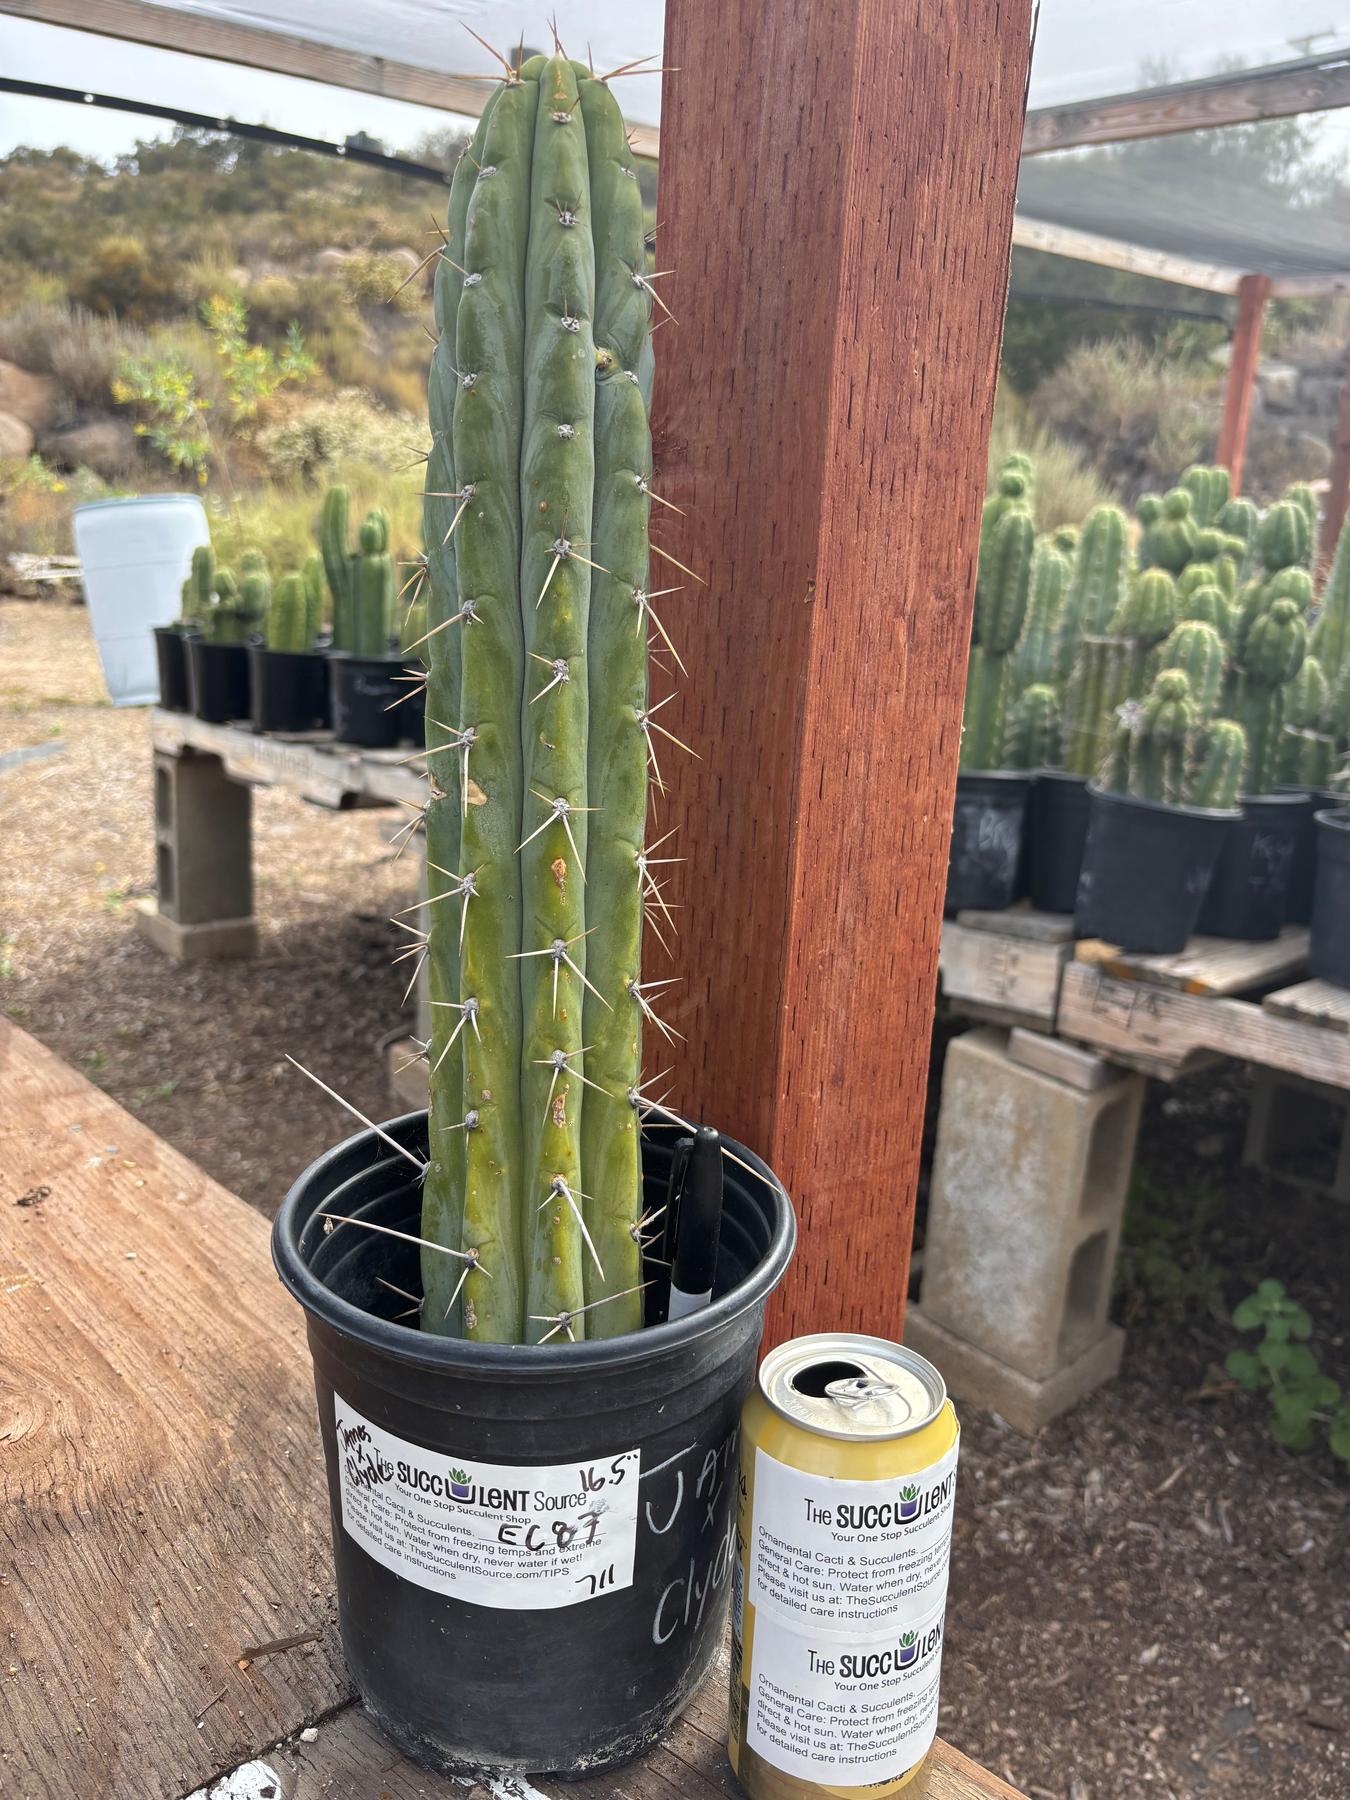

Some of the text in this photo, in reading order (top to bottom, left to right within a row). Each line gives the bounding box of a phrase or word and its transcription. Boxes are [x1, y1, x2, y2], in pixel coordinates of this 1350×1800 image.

[385, 1496, 406, 1514] Cacti
[408, 1510, 415, 1519] &
[417, 1513, 475, 1537] Succulents.
[395, 1483, 532, 1526] Your One Stop Succulent Shop
[534, 1491, 587, 1512] Source
[371, 1509, 382, 1523] hot
[404, 1529, 430, 1547] Water
[433, 1542, 459, 1557] when
[484, 1557, 514, 1568] never
[518, 1560, 548, 1568] water
[551, 1558, 559, 1566] if
[560, 1553, 583, 1565] wet!
[372, 1499, 392, 1518] Care:
[395, 1513, 426, 1535] Protect
[428, 1530, 450, 1543] from
[453, 1537, 495, 1555] freezing
[498, 1546, 532, 1558] temps
[535, 1546, 555, 1556] and
[559, 1538, 602, 1554] extreme
[759, 1525, 918, 1566] Ornamental Cacti & Succulents.
[832, 1532, 855, 1542] Your
[857, 1534, 878, 1542] One
[880, 1531, 902, 1541] Stop
[904, 1512, 939, 1536] Succulent
[356, 1520, 382, 1545] detailed
[384, 1543, 402, 1555] care
[404, 1552, 456, 1579] instructions
[369, 1519, 382, 1535] visit
[384, 1531, 394, 1541] us
[397, 1538, 407, 1548] at:
[409, 1543, 570, 1579] TheSucculentSource.com/TIPS
[758, 1539, 792, 1566] General
[795, 1560, 824, 1576] Care:
[828, 1568, 868, 1579] Protect
[871, 1567, 895, 1579] from
[898, 1552, 933, 1573] freezing
[757, 1564, 786, 1589] Please
[788, 1586, 809, 1599] visit
[812, 1594, 825, 1603] us
[828, 1595, 843, 1604] at:
[758, 1553, 780, 1573] direct
[782, 1568, 790, 1578] &
[792, 1572, 810, 1585] hot
[812, 1581, 836, 1591] sun.
[840, 1582, 873, 1592] Water
[876, 1579, 903, 1590] when
[757, 1577, 898, 1620] for detailed care instructions
[759, 1673, 916, 1713] Ornamental Cacti & Succulents.
[834, 1682, 857, 1691] Your
[859, 1682, 879, 1691] One
[881, 1677, 901, 1688] Stop
[757, 1699, 781, 1720] direct
[783, 1715, 791, 1725] &
[794, 1720, 811, 1733] hot
[814, 1729, 837, 1738] sun.
[841, 1730, 873, 1739] Water
[876, 1722, 902, 1735] when
[758, 1686, 928, 1727] General Care: Protect from freezing
[757, 1710, 787, 1736] Please
[790, 1732, 811, 1745] visit
[813, 1741, 826, 1750] us
[829, 1742, 843, 1751] at:
[757, 1722, 897, 1764] for detailed care instructions
